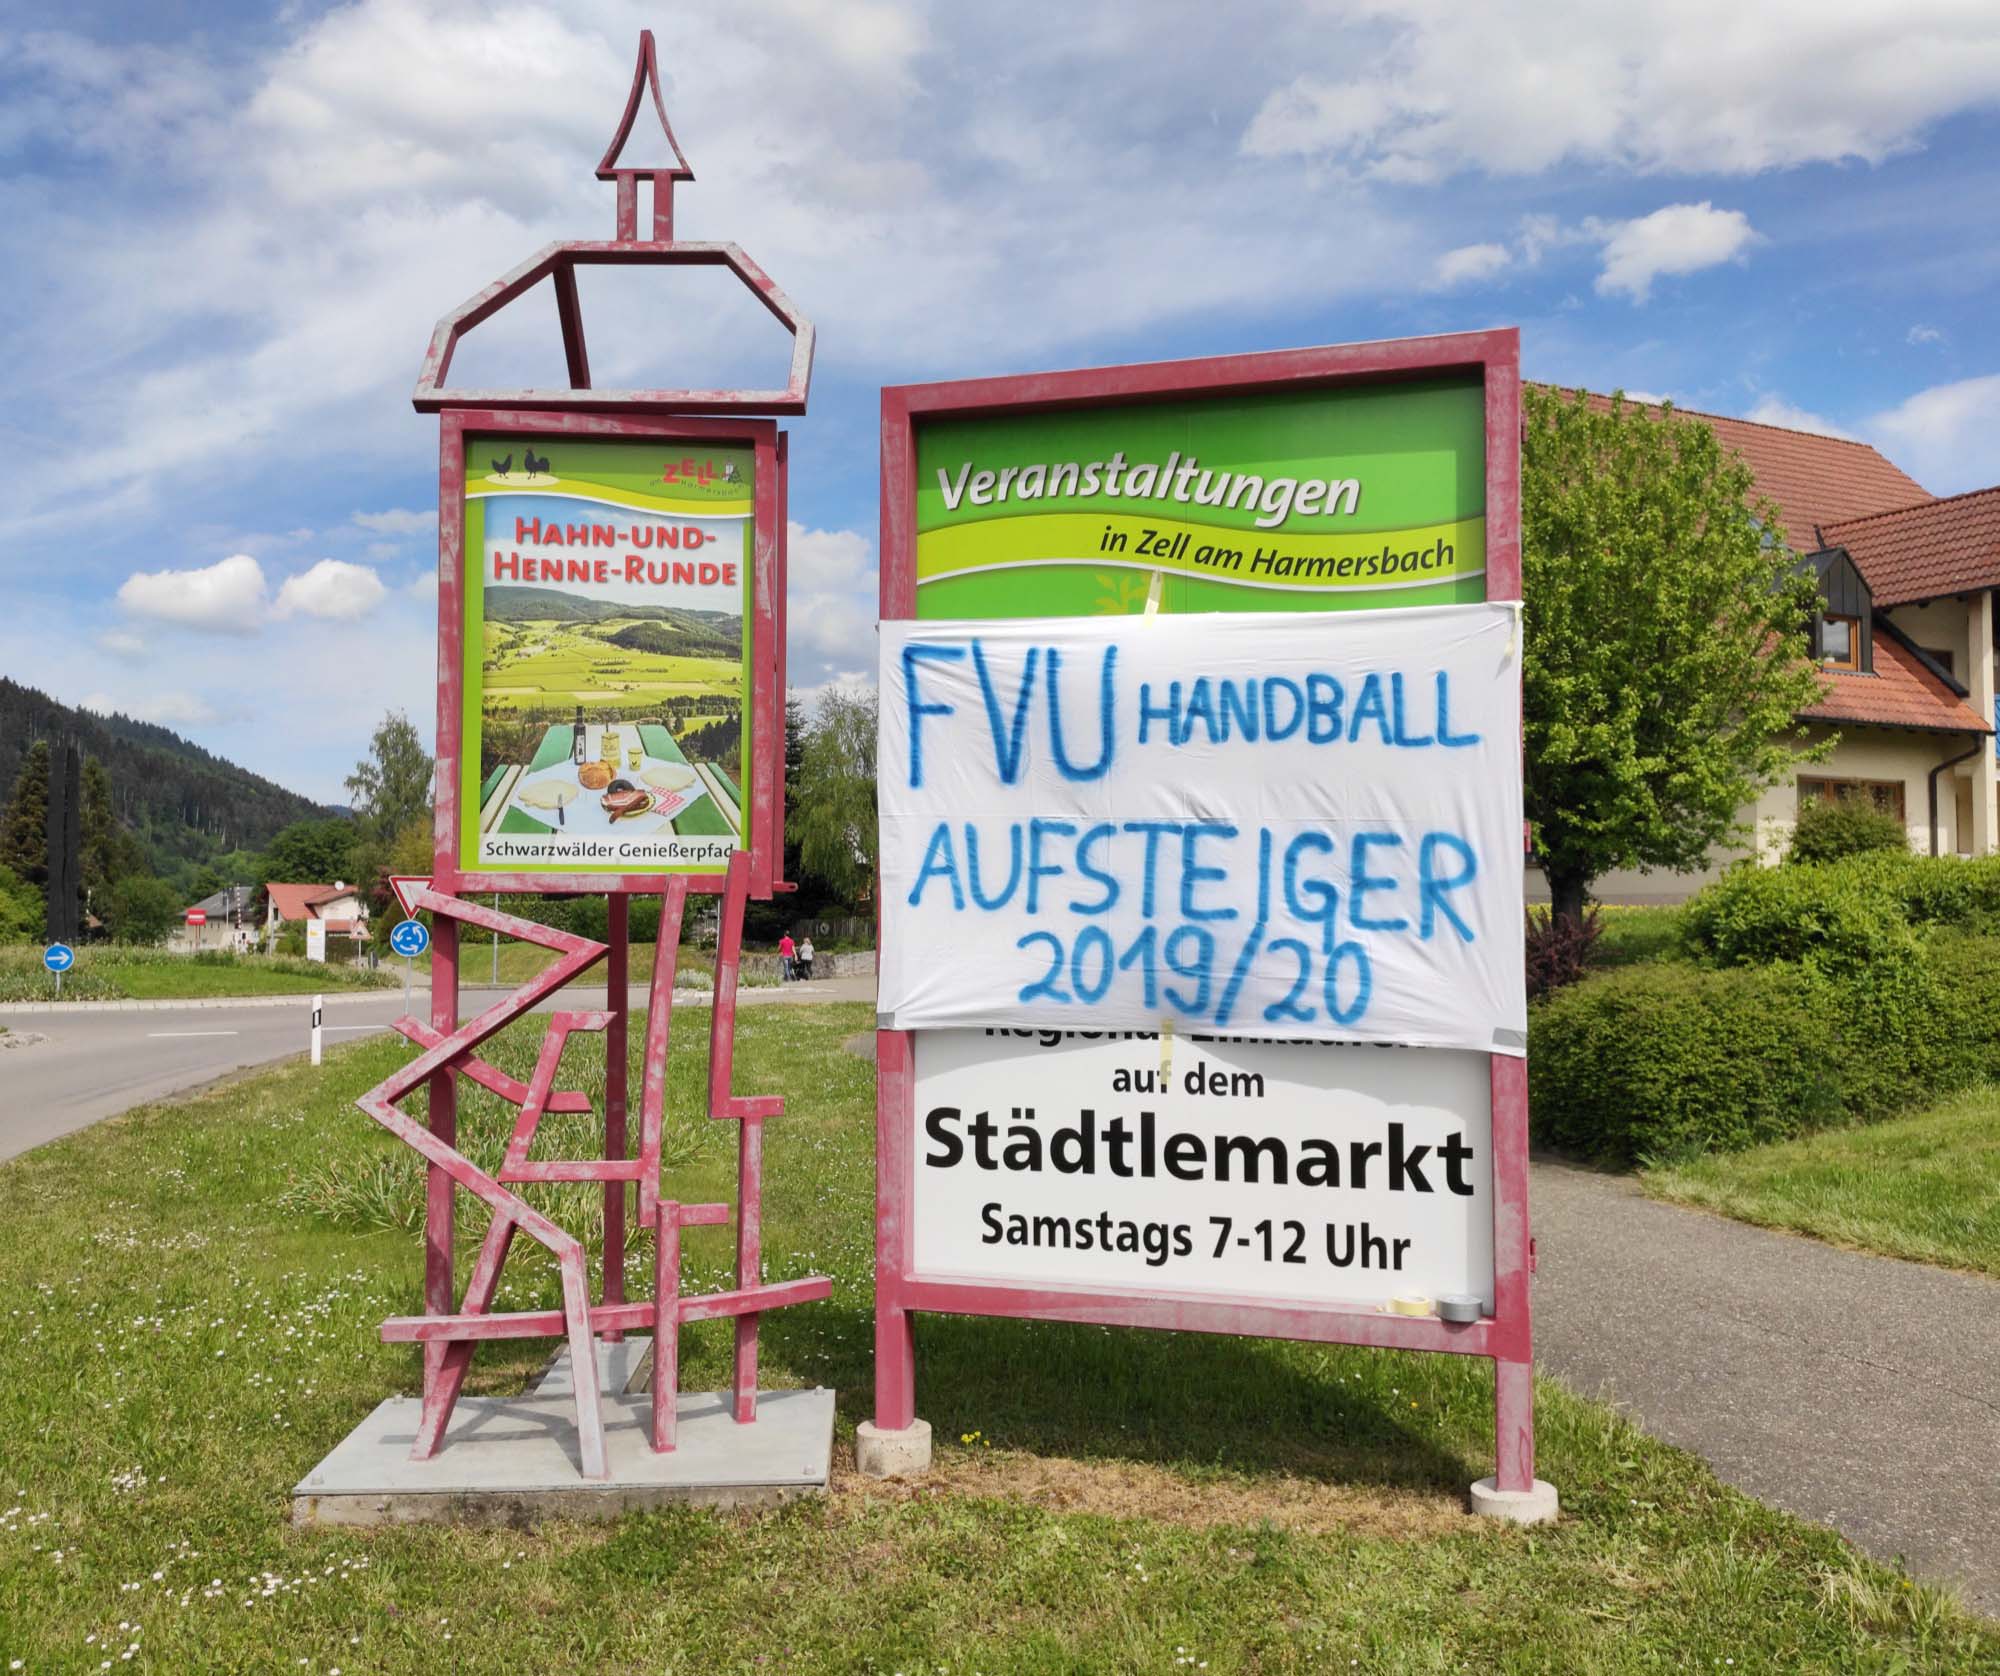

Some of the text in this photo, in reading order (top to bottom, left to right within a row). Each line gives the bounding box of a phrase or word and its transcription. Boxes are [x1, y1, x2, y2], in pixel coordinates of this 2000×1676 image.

[662, 457, 719, 486] ZELL
[937, 452, 1360, 527] Veranstaltungen
[1100, 526, 1455, 578] in Zell am Harmersbach
[903, 639, 1481, 788] FVU HANDBALL
[486, 841, 733, 862] Schwarzwälder Genießerpfad
[908, 818, 1478, 955] AUFSTEIGER
[1017, 924, 1373, 1026] 2019/20
[1184, 1062, 1265, 1097] dem
[925, 1107, 1475, 1196] Städtlemarkt
[981, 1203, 1412, 1271] Samstags 7-12 Uhr
